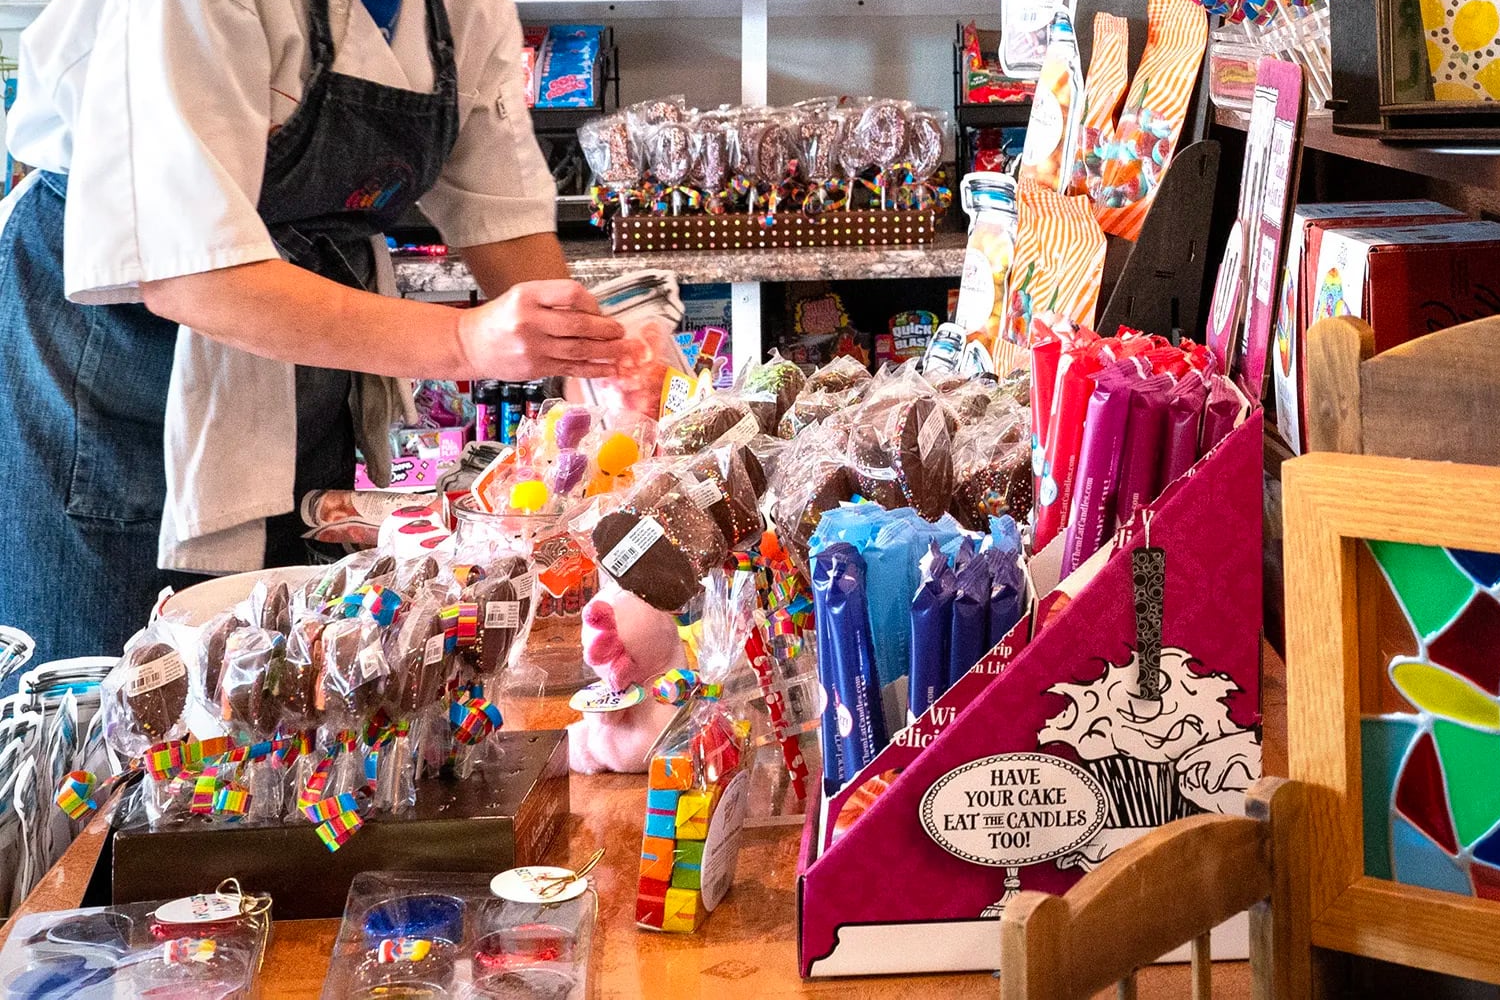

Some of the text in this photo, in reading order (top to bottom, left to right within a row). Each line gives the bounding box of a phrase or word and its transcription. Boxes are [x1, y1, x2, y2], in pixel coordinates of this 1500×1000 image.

[892, 323, 932, 337] QUICK
[1057, 454, 1077, 534] ThemEatCandles.com
[987, 642, 1013, 662] rip
[856, 675, 870, 767] ThemEatCandles.com
[991, 768, 1041, 786] HAVE
[965, 788, 1067, 808] YOUR CAKE
[944, 809, 1088, 831] EAT THE CANDLES
[988, 832, 1031, 849] TOO!
